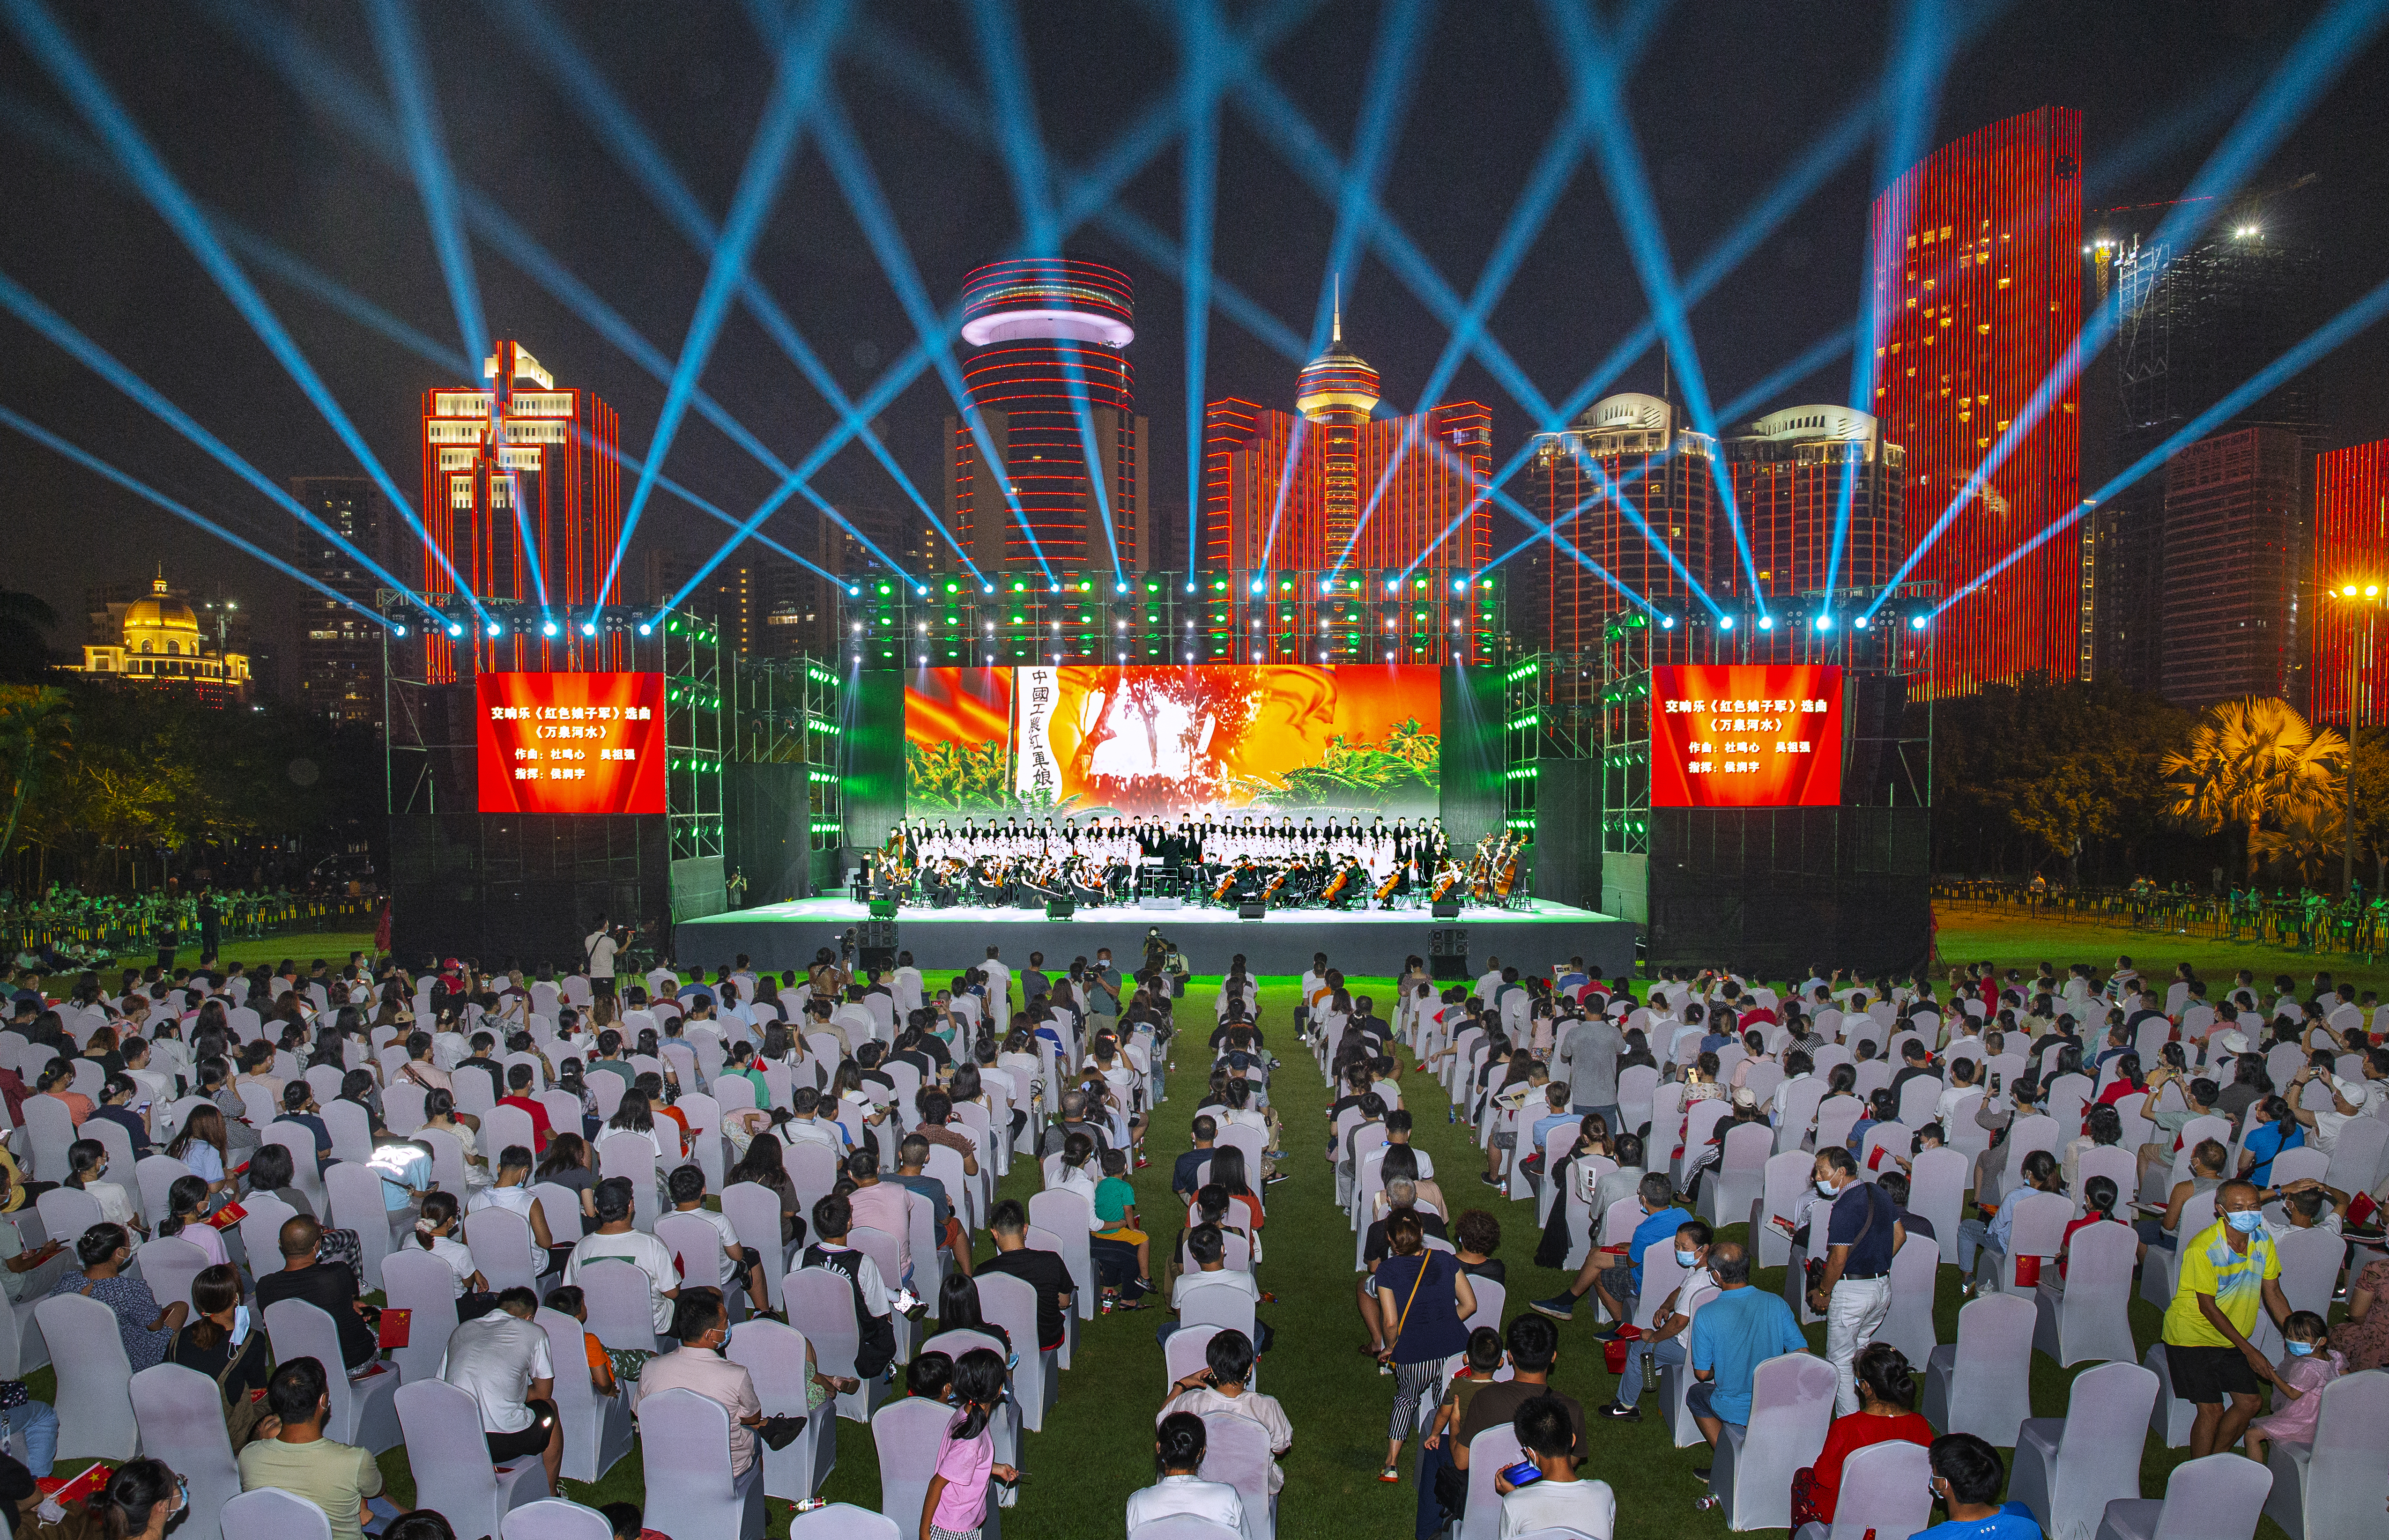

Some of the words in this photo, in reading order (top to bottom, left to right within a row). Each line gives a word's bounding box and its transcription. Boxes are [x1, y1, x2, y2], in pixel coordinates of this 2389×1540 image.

[1666, 699, 1826, 712] 交响乐《红色娘子军》选曲
[492, 707, 650, 719] 交响乐《红色娘子军》选曲
[1029, 670, 1054, 791] 中國工農紅軍娘
[1711, 718, 1781, 731] 《万泉河水》
[536, 726, 606, 738] 《万泉河水》
[1776, 741, 1810, 752] 吴祖强
[601, 749, 635, 760] 吴祖强
